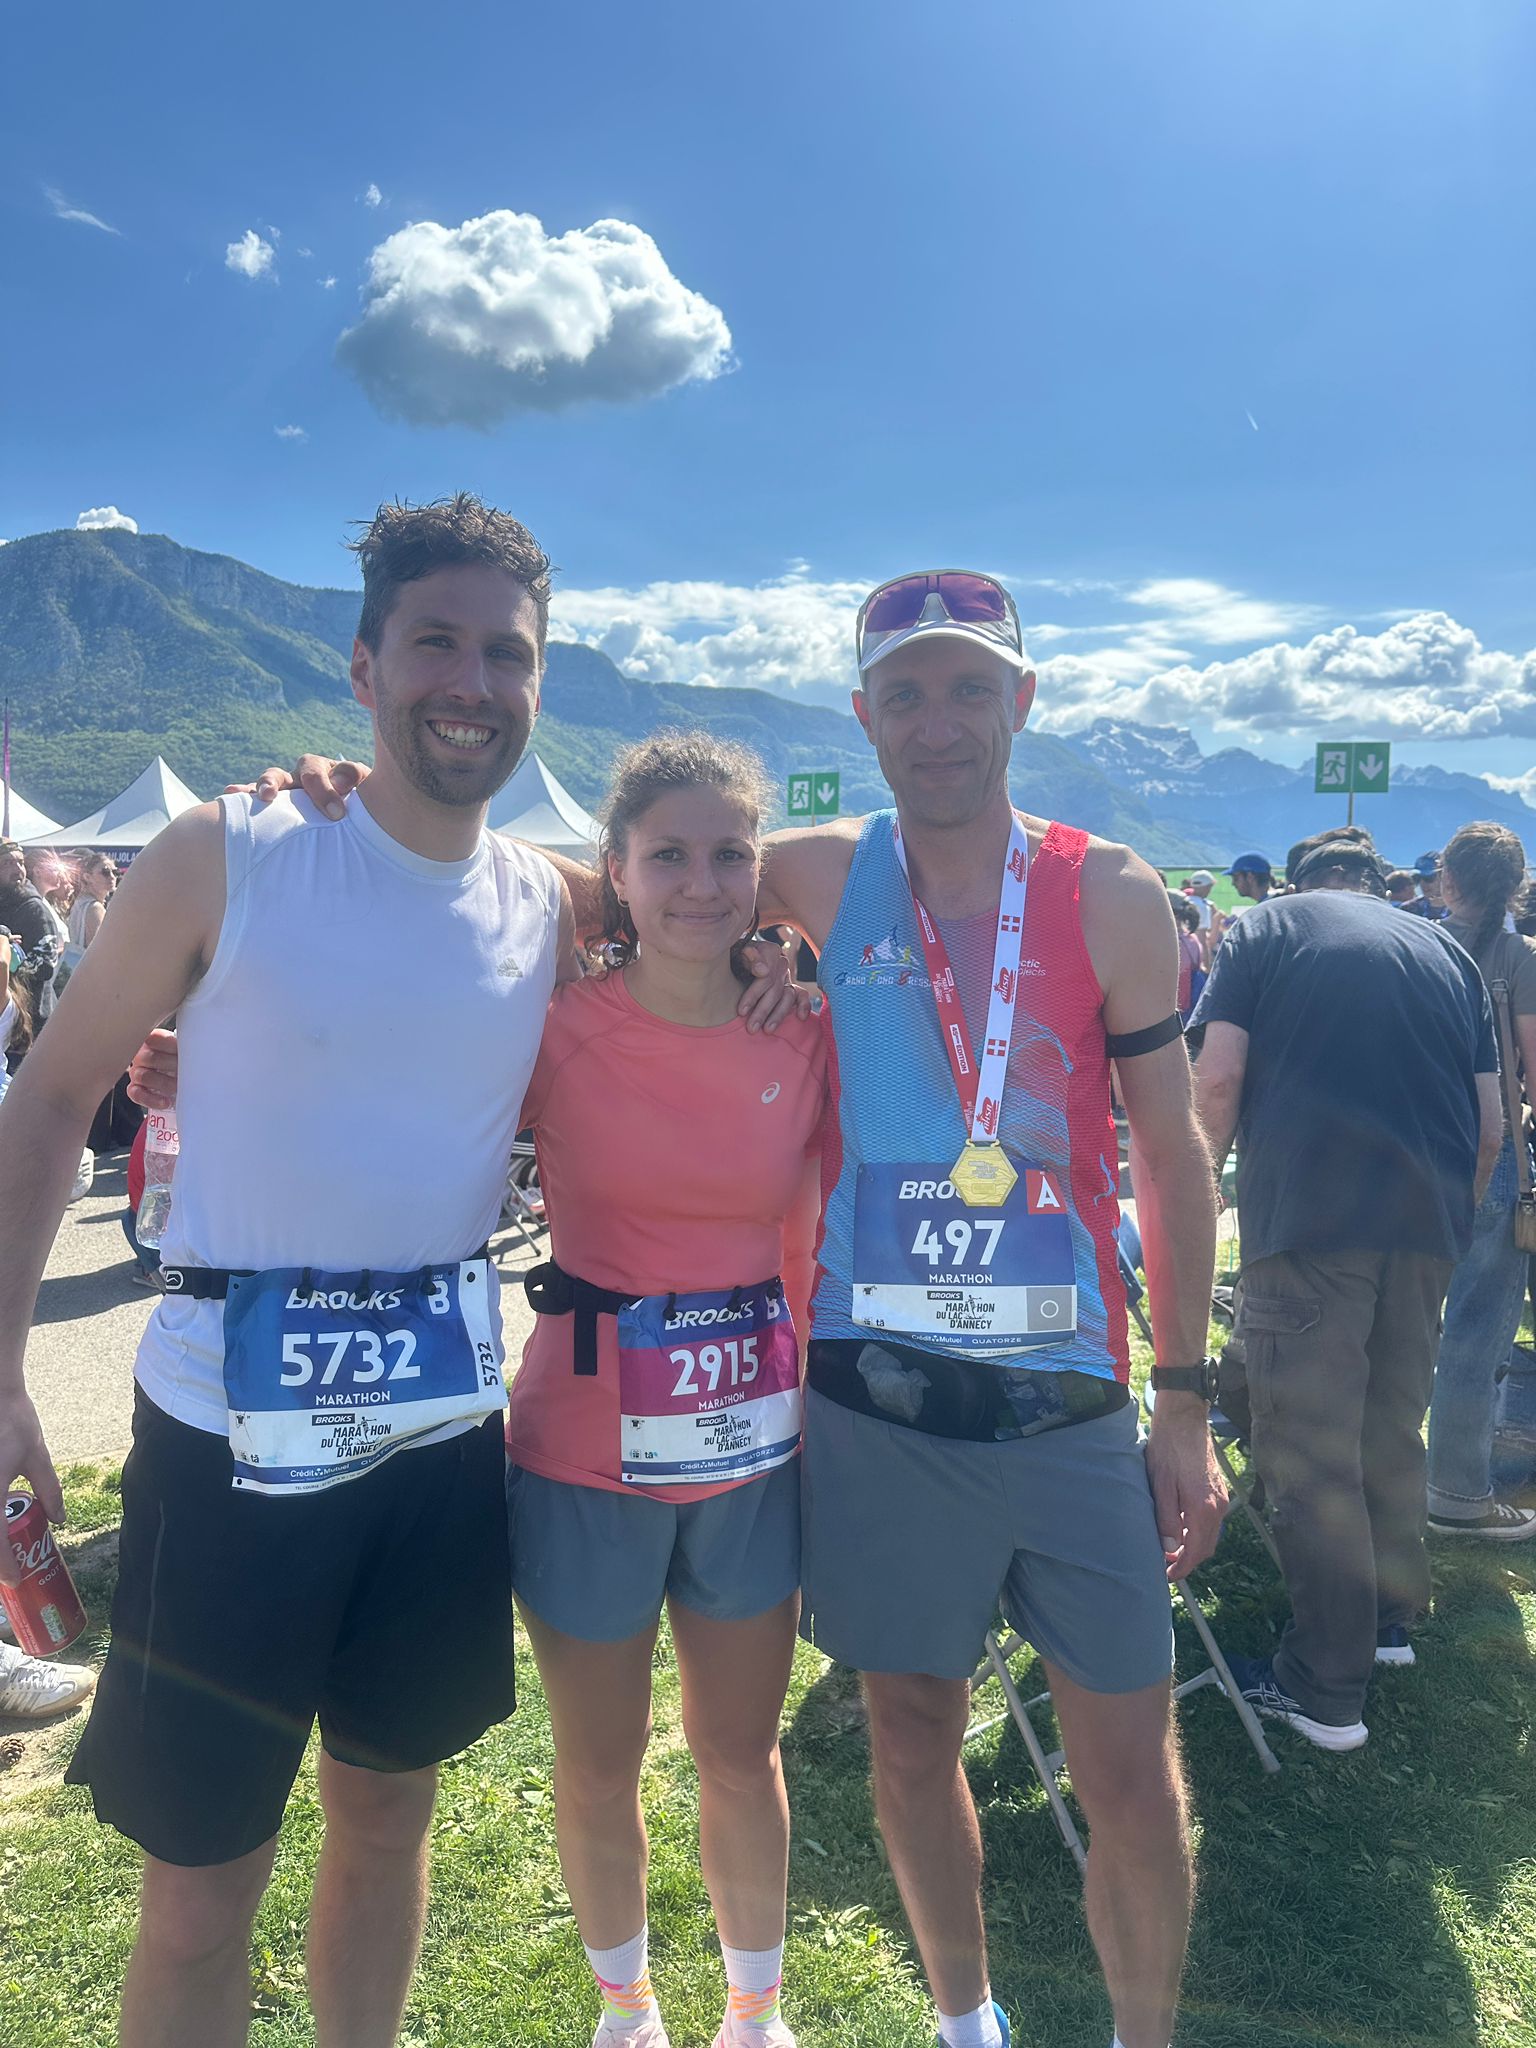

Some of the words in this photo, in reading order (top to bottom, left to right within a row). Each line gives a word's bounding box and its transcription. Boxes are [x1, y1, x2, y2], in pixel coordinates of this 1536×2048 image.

[102, 851, 138, 862] AUJOLA
[1020, 959, 1040, 968] ctic
[150, 1114, 166, 1129] an
[898, 1180, 963, 1200] BRO
[1036, 1175, 1061, 1208] A
[911, 1219, 1006, 1266] 497
[929, 1273, 993, 1284] MARATHON
[285, 1288, 405, 1311] BROOKS
[427, 1280, 451, 1315] B
[665, 1300, 754, 1330] BROOKS
[936, 1311, 946, 1319] DU
[948, 1311, 963, 1320] LAC
[950, 1319, 992, 1329] D'ANNECY
[940, 1336, 962, 1344] Mutuel
[279, 1329, 421, 1387] 5732
[477, 1341, 499, 1387] 5732
[669, 1336, 759, 1397] 2915
[315, 1390, 391, 1407] MARATHON
[698, 1391, 745, 1411] MARATHON
[315, 1415, 352, 1424] BROOKS
[699, 1415, 726, 1426] BROOKS
[321, 1438, 333, 1448] DU
[336, 1437, 354, 1448] LAC
[704, 1437, 715, 1446] DU
[716, 1434, 730, 1444] LAC
[717, 1435, 752, 1453] D'ANNECY
[738, 1447, 775, 1463] QUATORZE
[707, 1460, 730, 1468] Mutuel
[290, 1468, 314, 1478] Crédit
